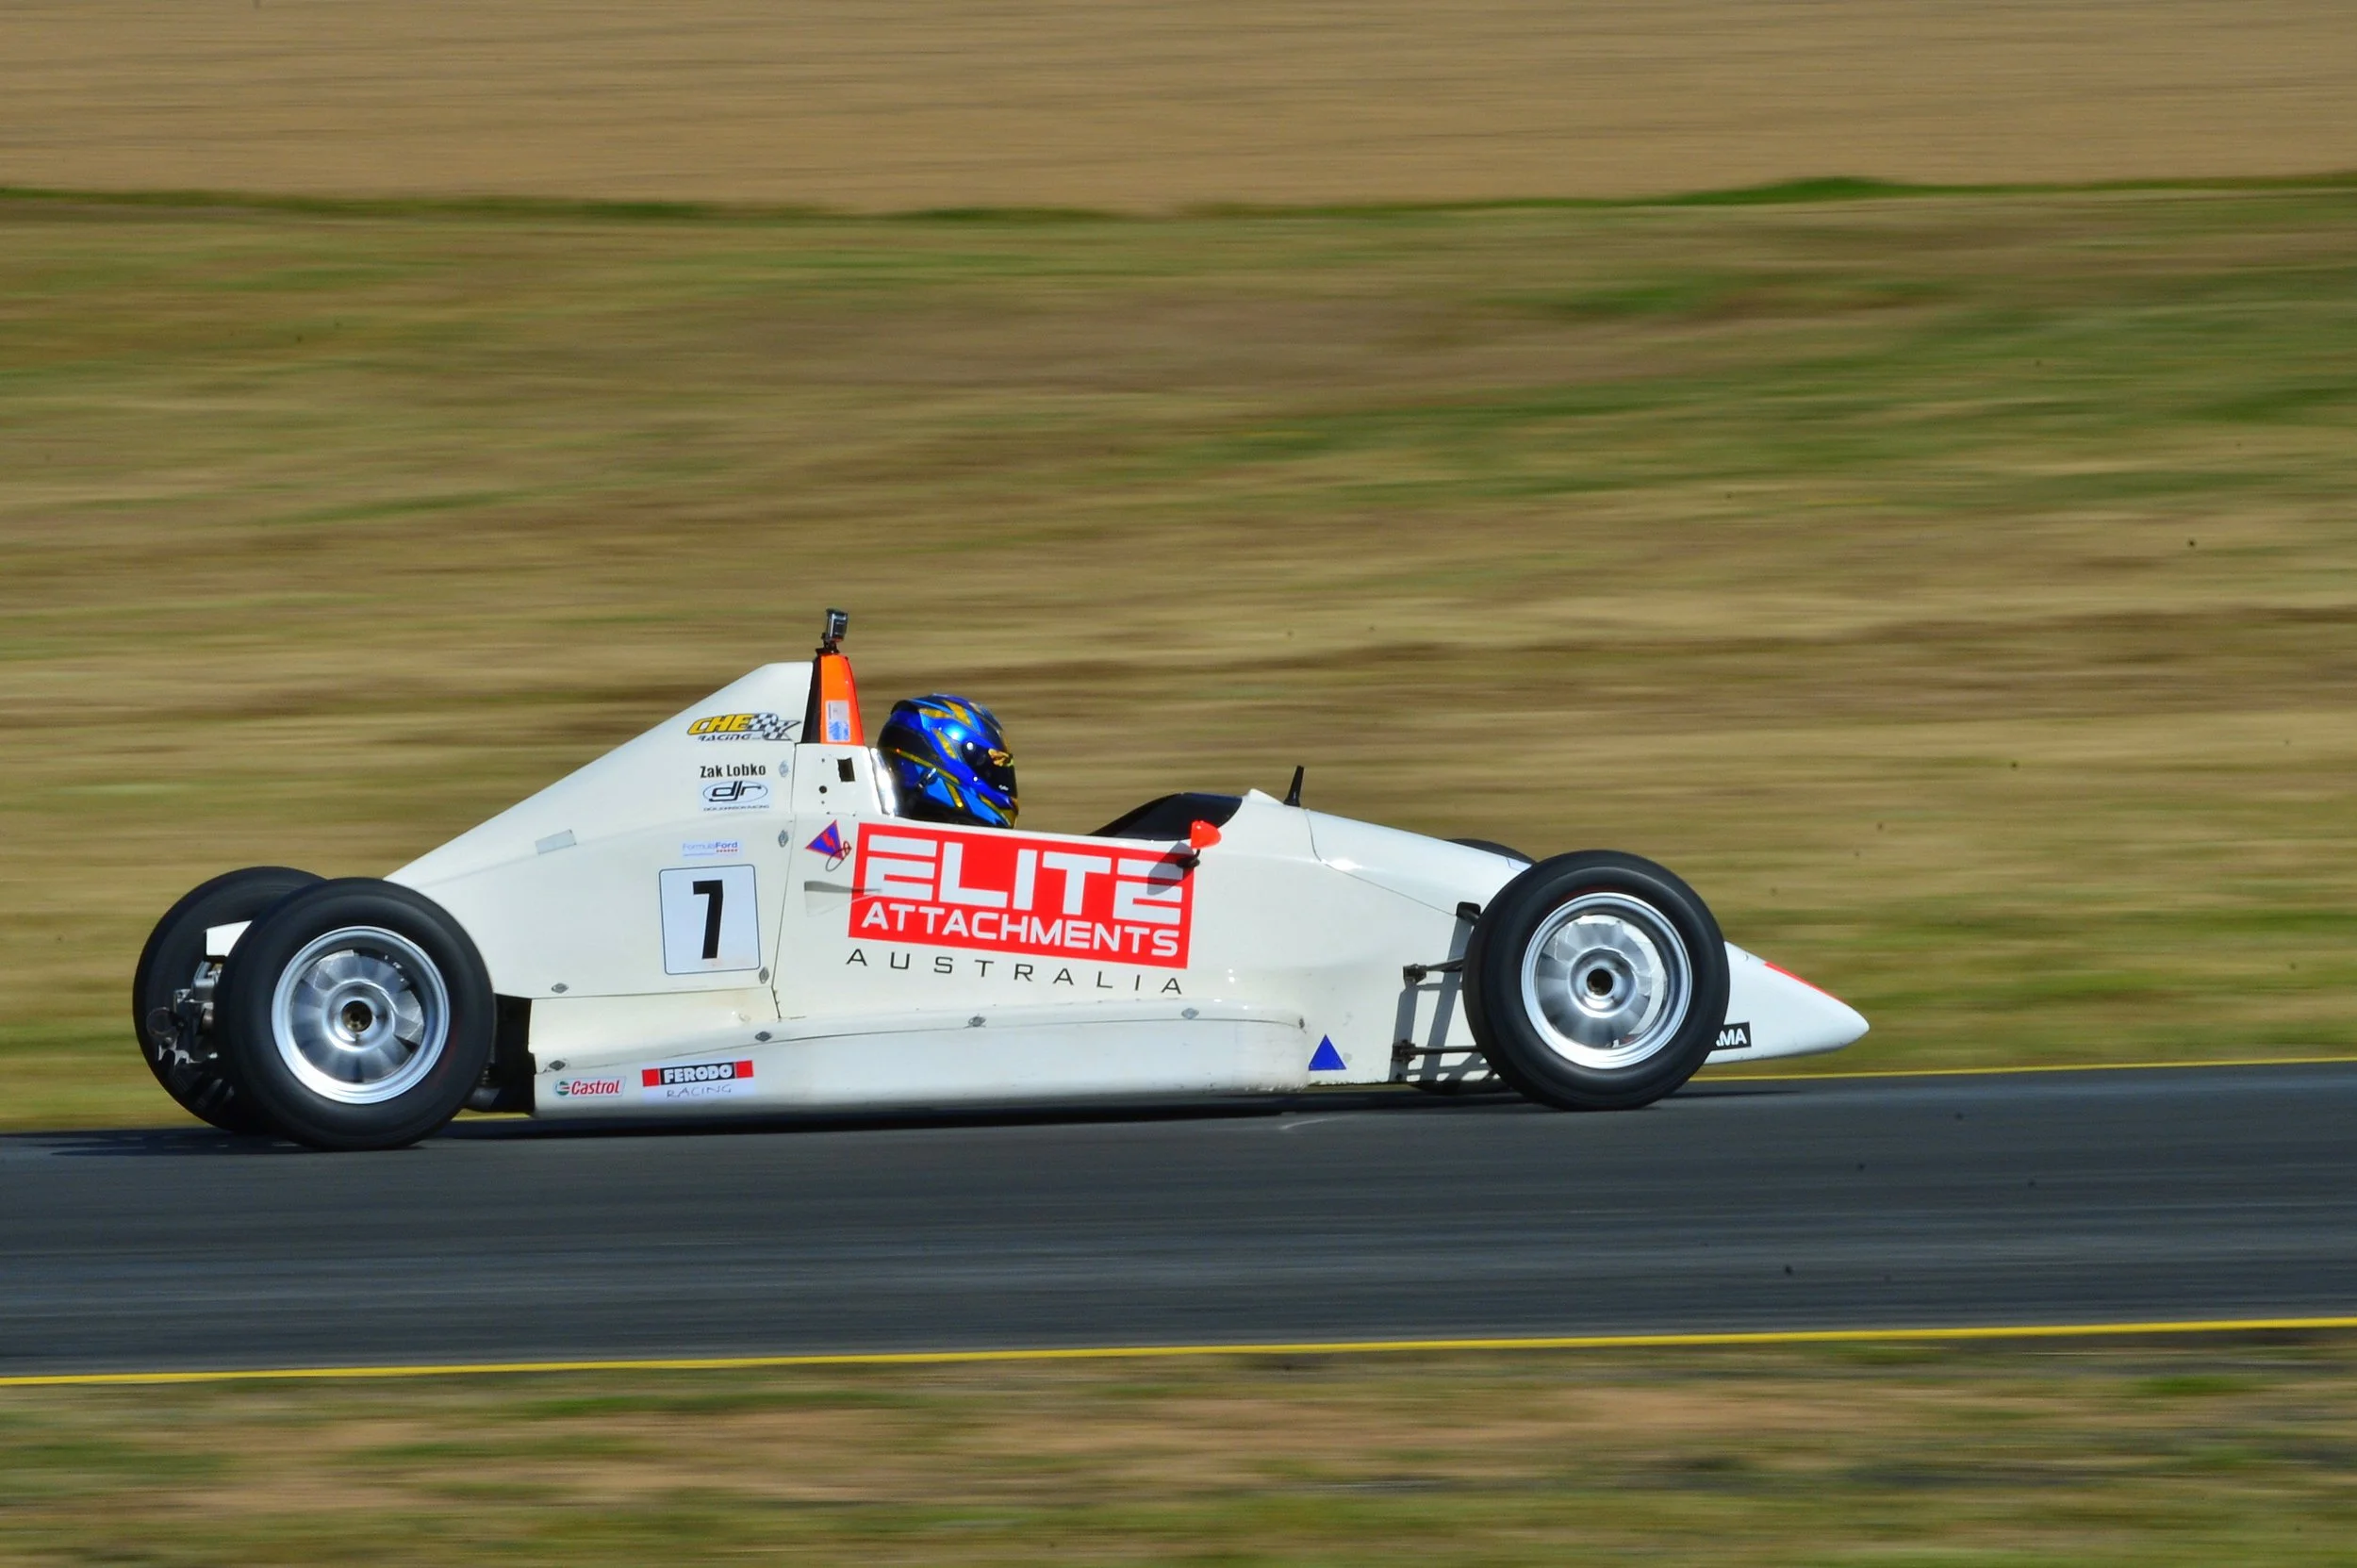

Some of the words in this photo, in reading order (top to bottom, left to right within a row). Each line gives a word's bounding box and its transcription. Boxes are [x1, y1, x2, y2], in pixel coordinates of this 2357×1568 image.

[700, 765, 723, 779] Zak
[726, 763, 766, 777] Lobko
[864, 834, 1182, 925] ELITE
[692, 879, 724, 960] 7
[861, 902, 1179, 957] ATTACHMENTS
[846, 948, 1182, 995] AUSTRALIA
[571, 1080, 619, 1096] Castrol
[664, 1065, 733, 1083] FERODO
[667, 1084, 732, 1098] RACING
